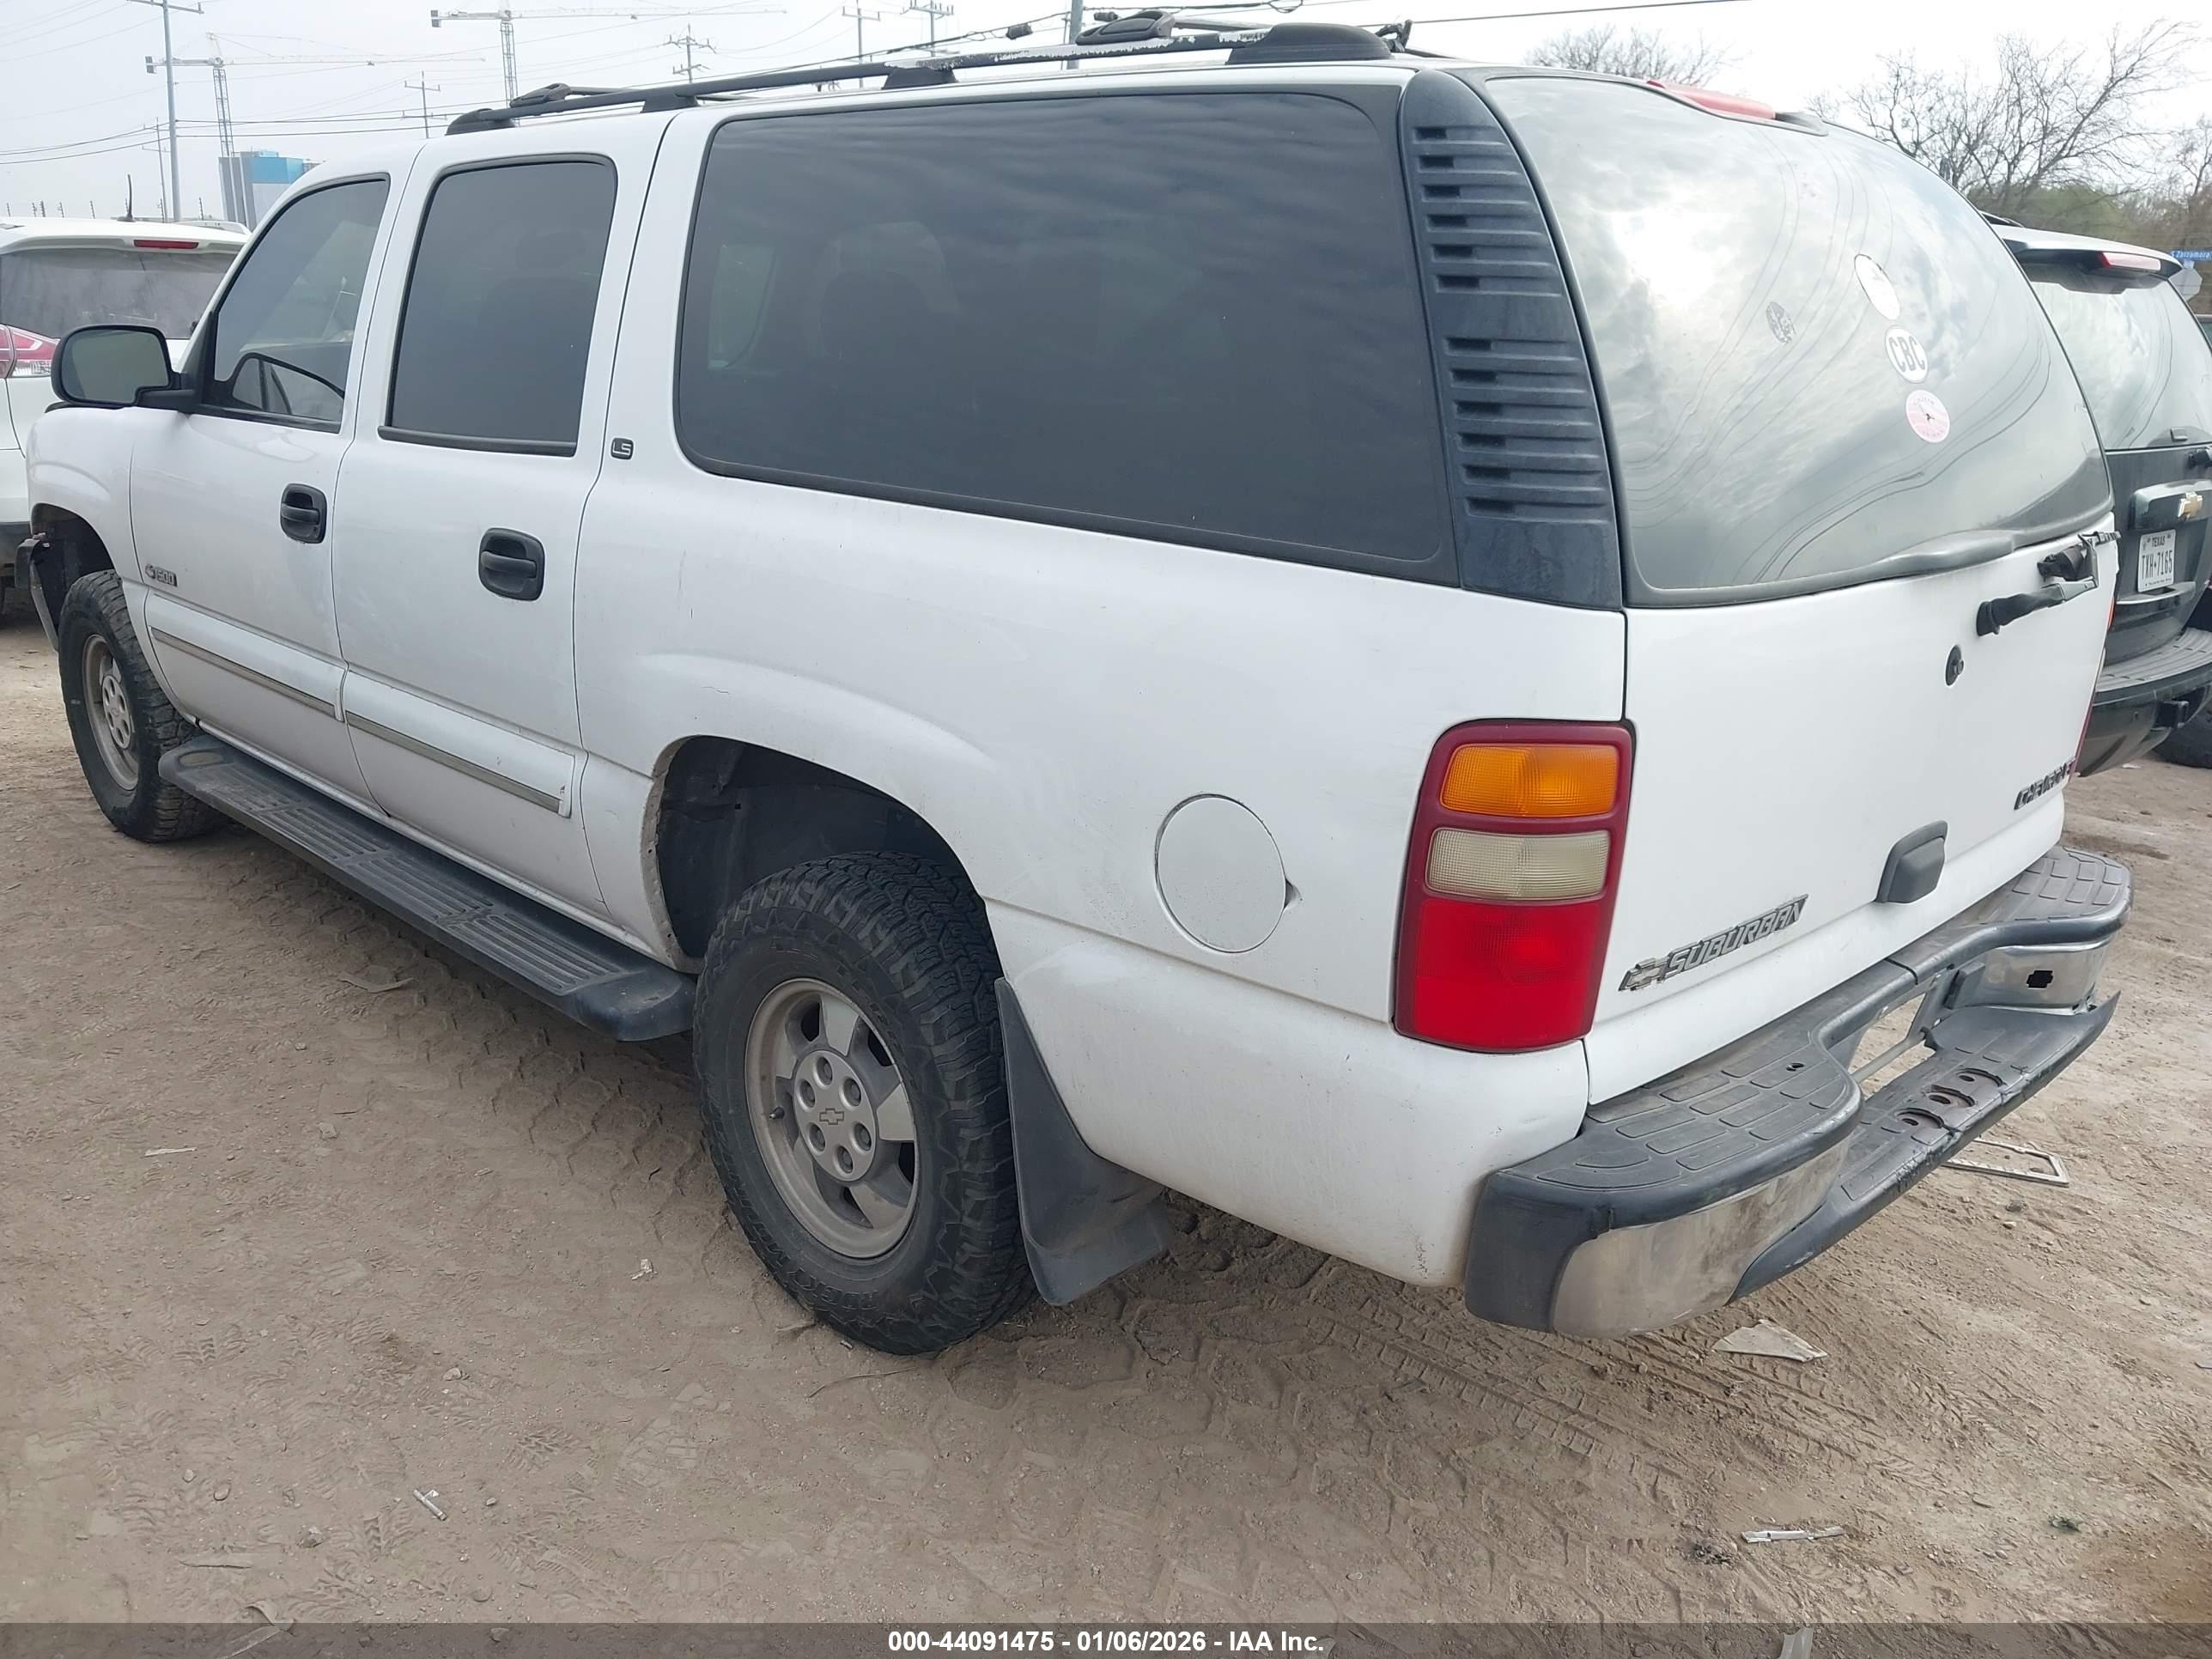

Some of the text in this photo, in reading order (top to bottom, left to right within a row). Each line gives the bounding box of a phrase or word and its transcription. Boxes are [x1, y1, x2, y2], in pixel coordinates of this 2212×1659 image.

[1889, 336, 1925, 372] CBC
[612, 441, 631, 456] LS
[2152, 536, 2166, 547] TEXAS
[1664, 895, 1808, 980] SUBURBAN
